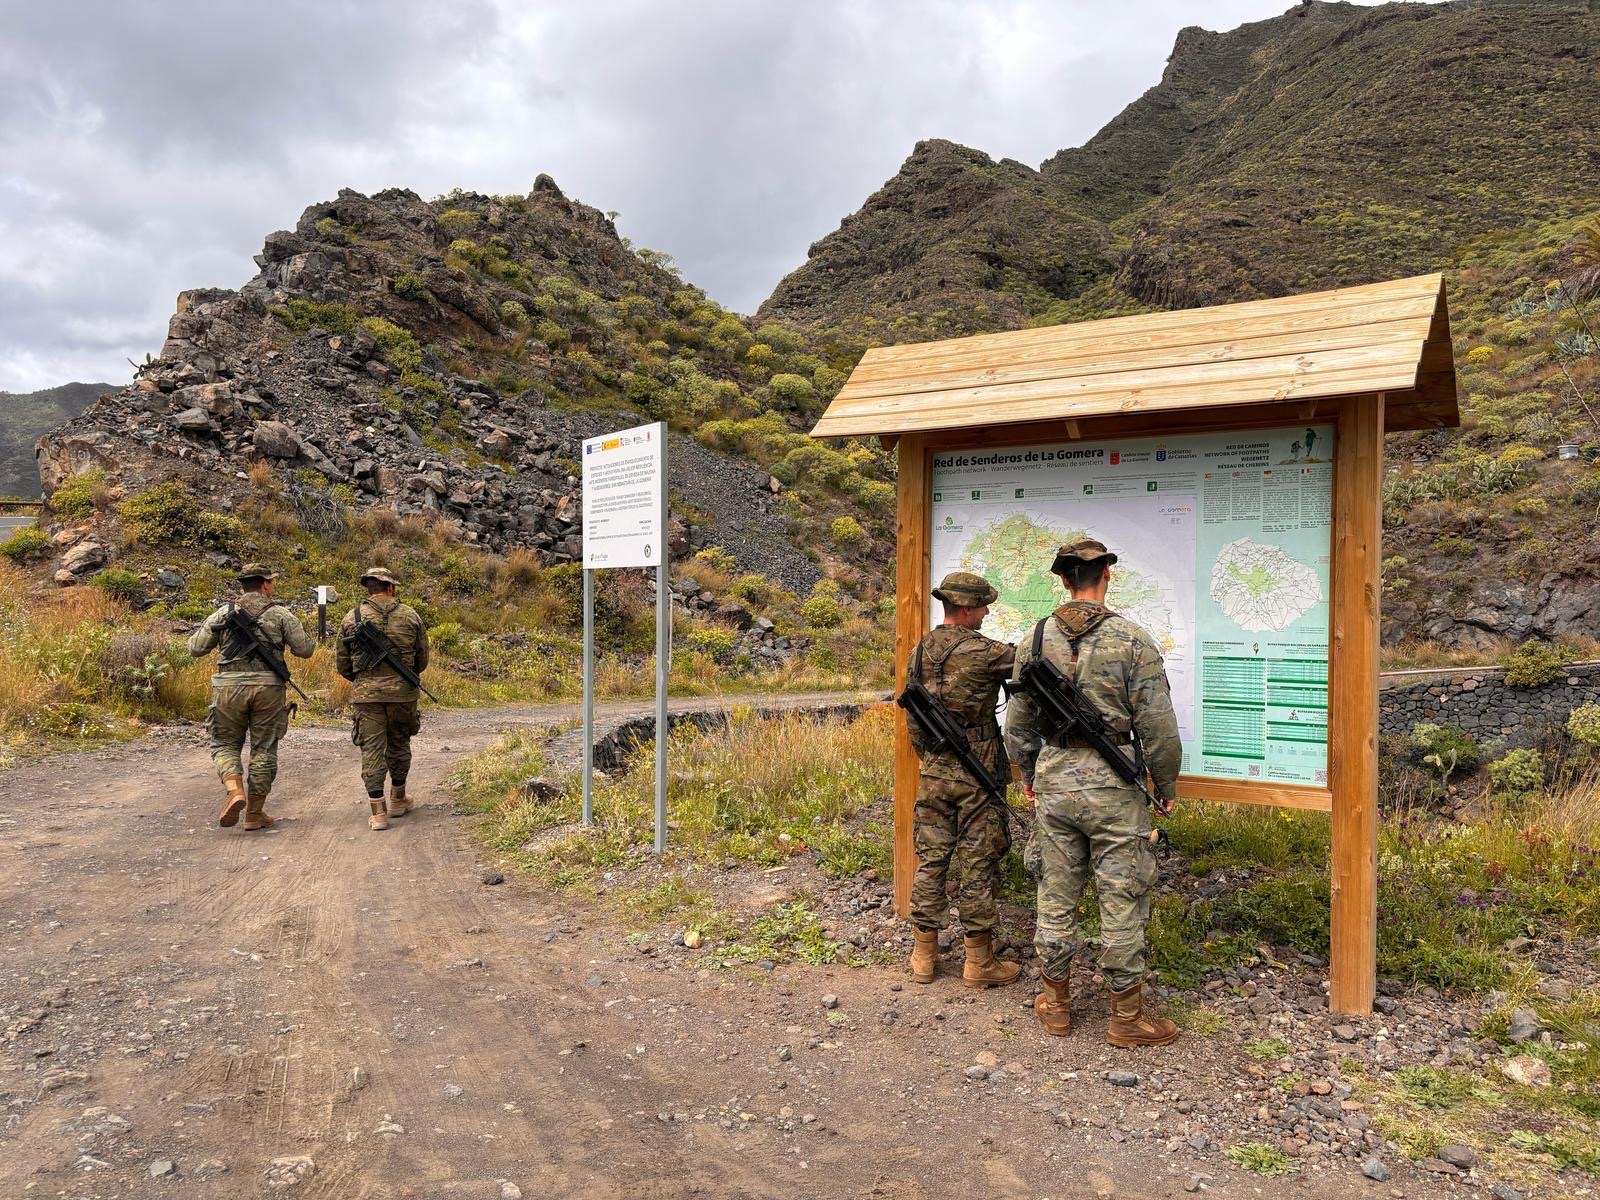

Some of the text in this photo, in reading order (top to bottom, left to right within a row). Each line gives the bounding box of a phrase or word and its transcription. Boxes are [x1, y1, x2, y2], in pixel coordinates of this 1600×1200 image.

[934, 449, 1104, 468] Red de Senderos de La Gomera
